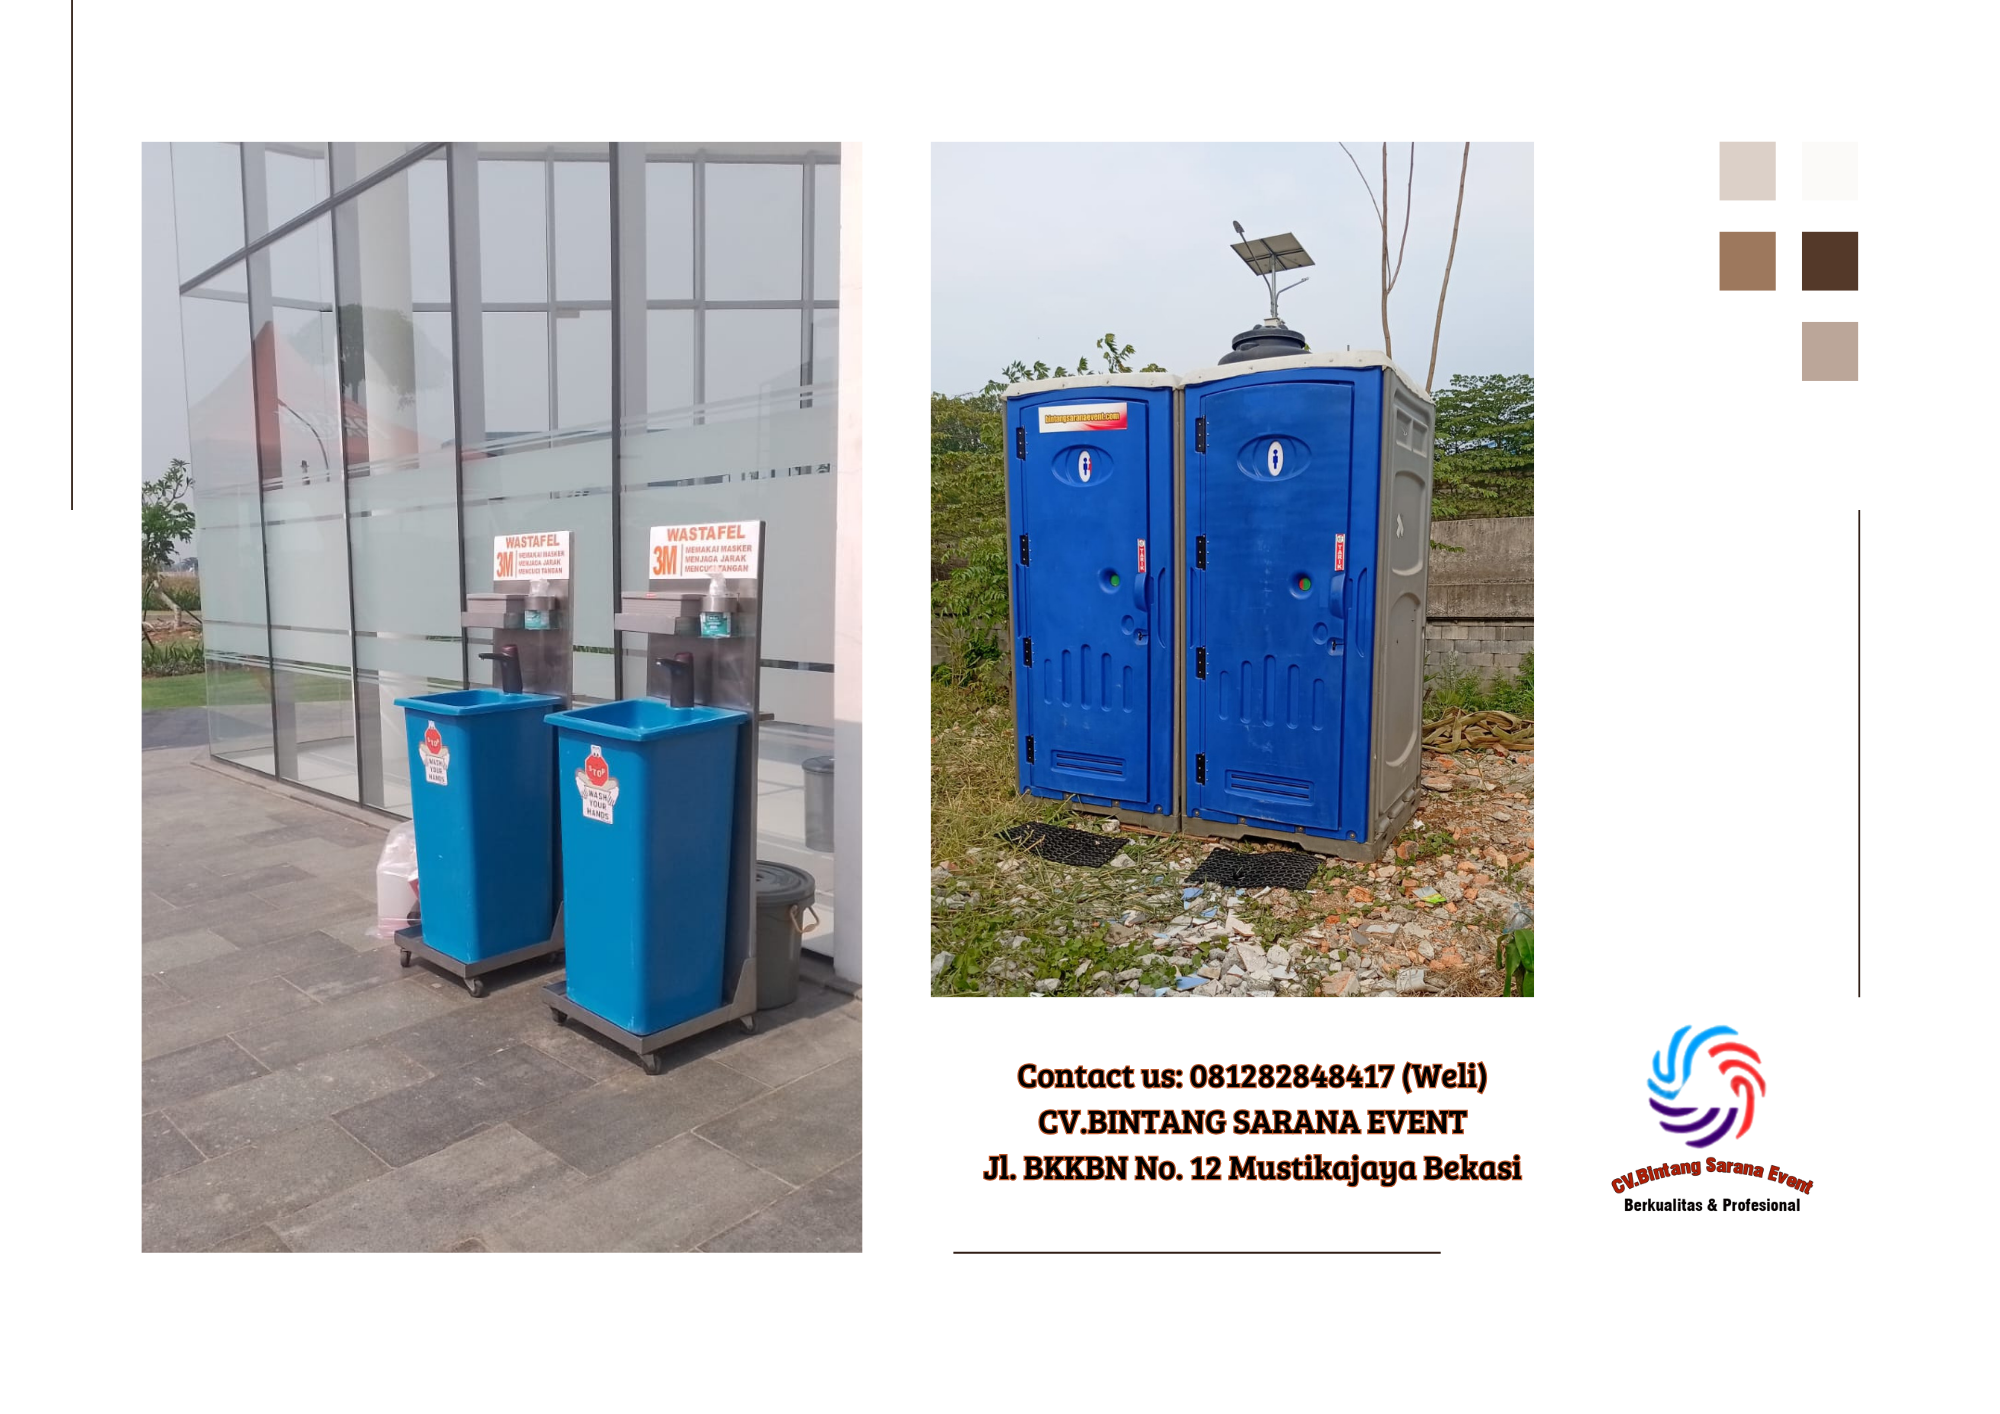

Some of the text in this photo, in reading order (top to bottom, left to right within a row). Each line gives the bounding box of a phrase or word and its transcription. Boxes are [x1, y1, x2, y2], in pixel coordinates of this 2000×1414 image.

[667, 524, 746, 542] WASTAFEL
[506, 534, 560, 549] WASTAFEL
[685, 544, 752, 554] MEMAKAI MASKER
[496, 551, 514, 577] 3M
[652, 545, 677, 575] 3M
[685, 554, 746, 563] MENJAGA JARAK
[588, 765, 606, 777] STOP
[588, 790, 608, 800] WASH
[589, 800, 607, 809] YOUR
[586, 807, 609, 820] HANDS
